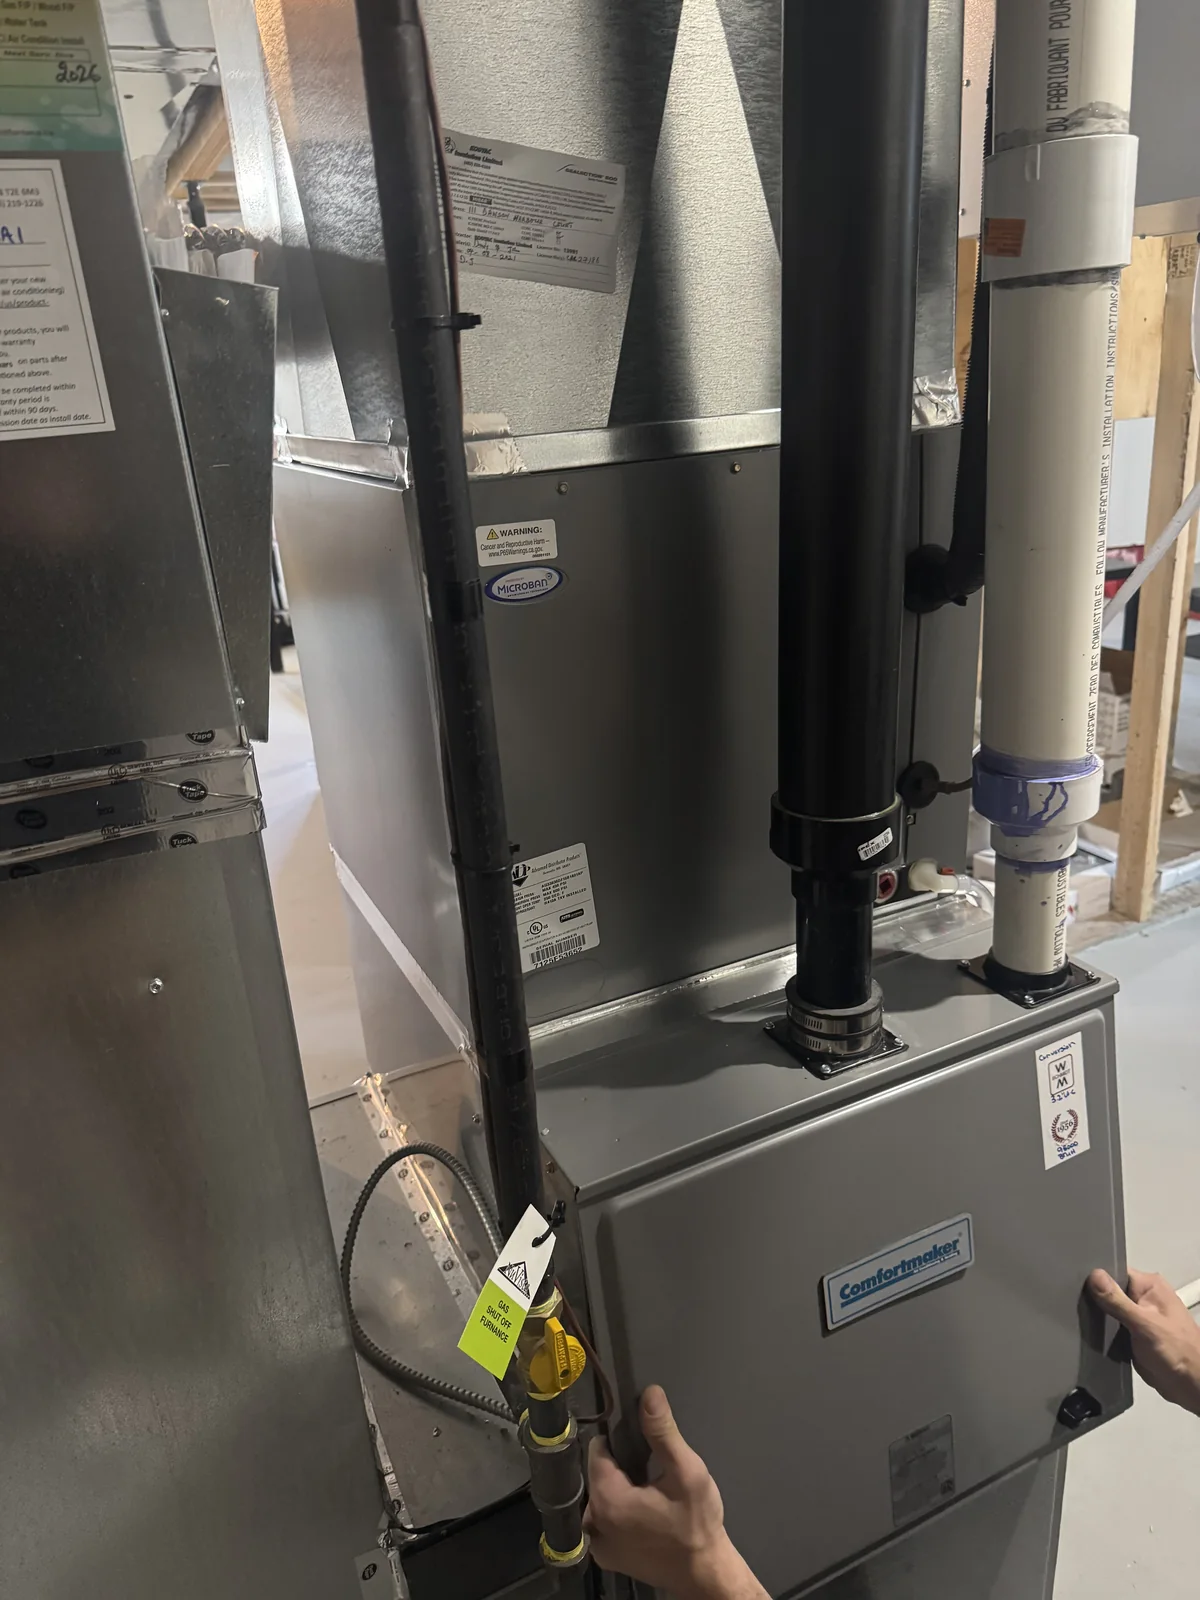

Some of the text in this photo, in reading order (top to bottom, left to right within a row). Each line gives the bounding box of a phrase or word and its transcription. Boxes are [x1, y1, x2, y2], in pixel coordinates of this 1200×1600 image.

[56, 60, 102, 83] 2026
[1046, 38, 1070, 111] FABRIQUANT
[1045, 116, 1070, 133] DU
[4, 328, 40, 336] products,
[41, 326, 55, 334] you
[30, 357, 49, 365] parts
[13, 385, 51, 394] completed
[19, 396, 43, 405] period
[4, 408, 27, 416] within
[40, 406, 58, 414] days.
[1103, 375, 1114, 448] INSTALLATION
[21, 417, 38, 425] date
[73, 413, 91, 421] date.
[1098, 454, 1110, 537] MANUFACTURER'S
[500, 526, 543, 537] WARNING:
[480, 543, 496, 551] Cancer
[506, 539, 533, 548] Reproductive
[193, 732, 211, 740] Tape
[173, 836, 192, 844] Tuck
[1057, 1121, 1074, 1133] 1956
[839, 1238, 960, 1300] Comfortmaker
[498, 1300, 510, 1314] GAS
[486, 1305, 512, 1330] SHUT OFF
[480, 1315, 509, 1344] FURNANCE
